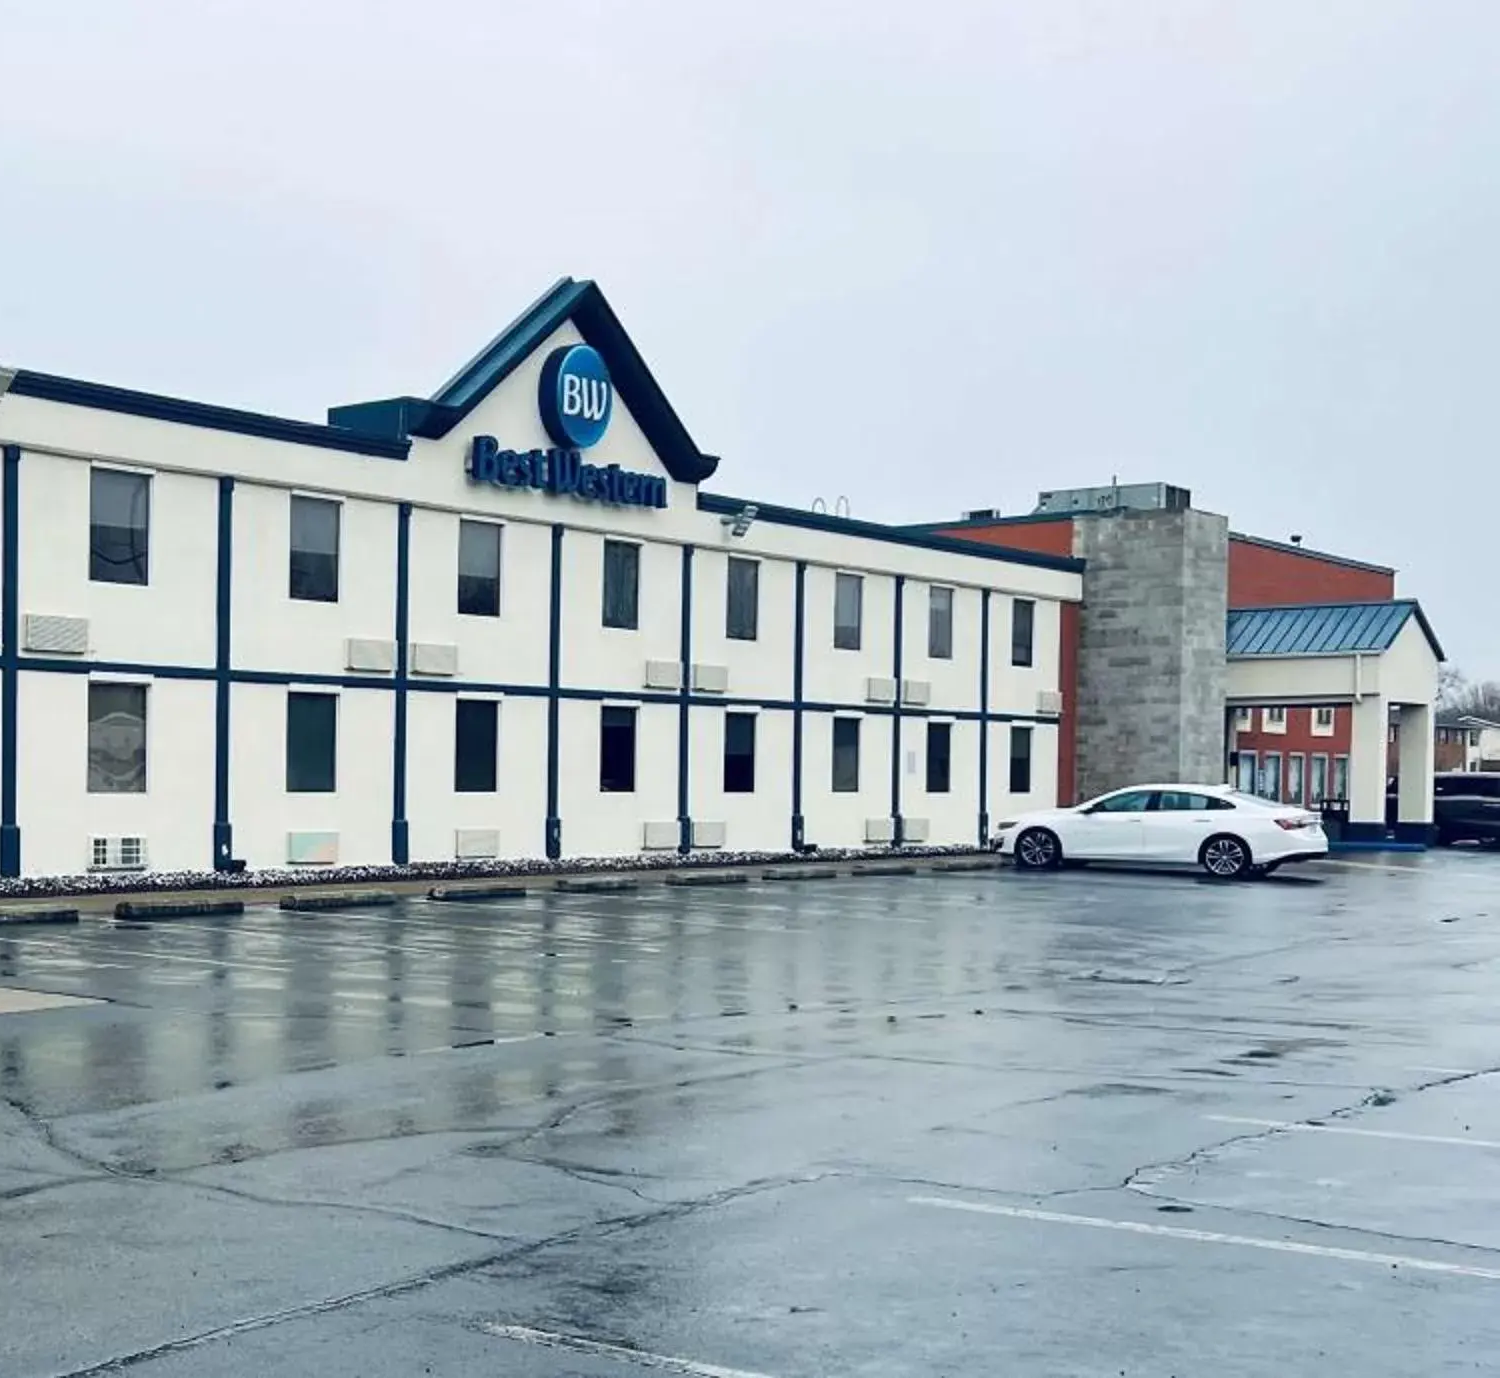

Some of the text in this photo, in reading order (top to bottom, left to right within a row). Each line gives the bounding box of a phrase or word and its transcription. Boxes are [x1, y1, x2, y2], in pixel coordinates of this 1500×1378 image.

[563, 373, 607, 420] BW
[472, 435, 667, 508] Best Western
